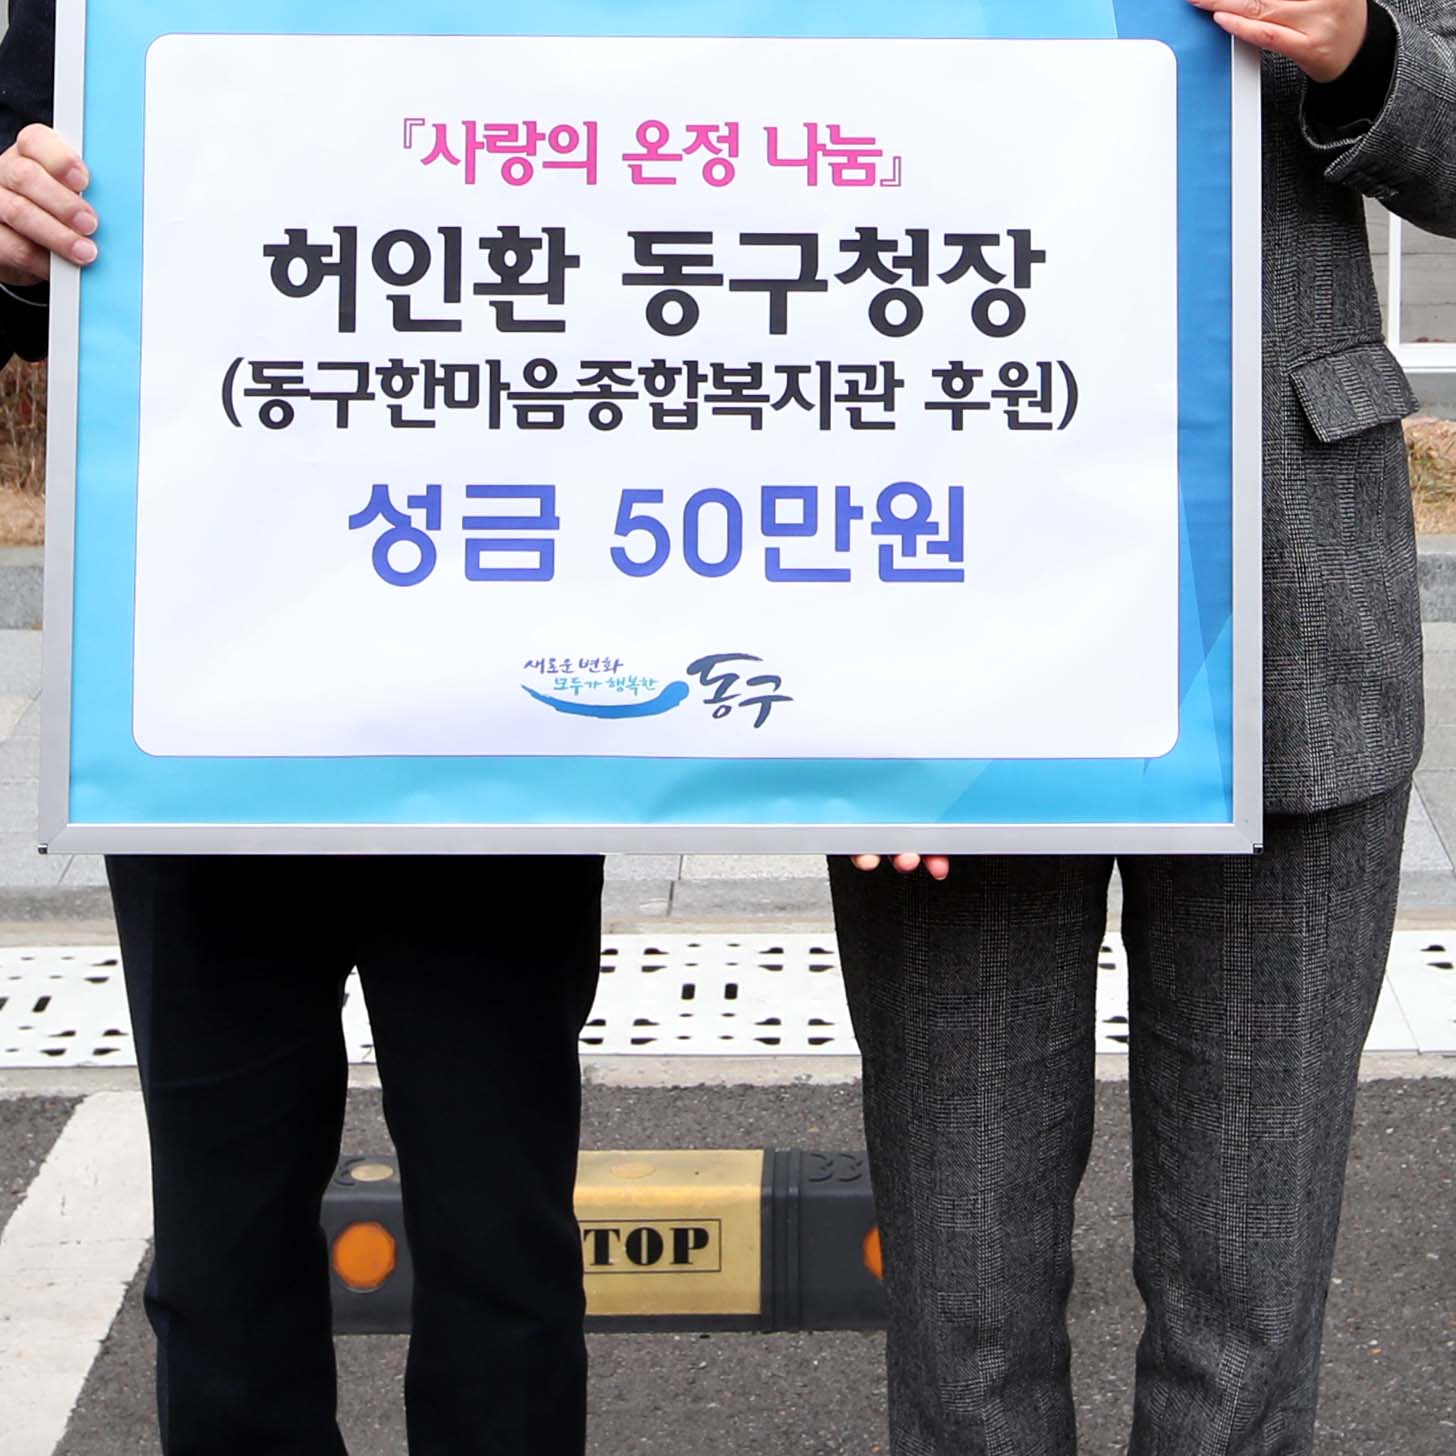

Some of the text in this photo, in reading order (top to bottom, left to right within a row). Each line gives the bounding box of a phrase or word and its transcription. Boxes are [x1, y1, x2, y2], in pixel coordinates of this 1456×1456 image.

[621, 119, 740, 188] 온정
[262, 225, 1047, 339] 허인환 동구청장
[221, 356, 1079, 433] (동구한마음종합복지관 후원)
[348, 481, 968, 589] 성금 50만원
[523, 656, 625, 675] 새로운 변화
[553, 675, 659, 697] 모두가 행복한
[685, 652, 795, 729] 동구
[584, 1226, 710, 1267] TOP
